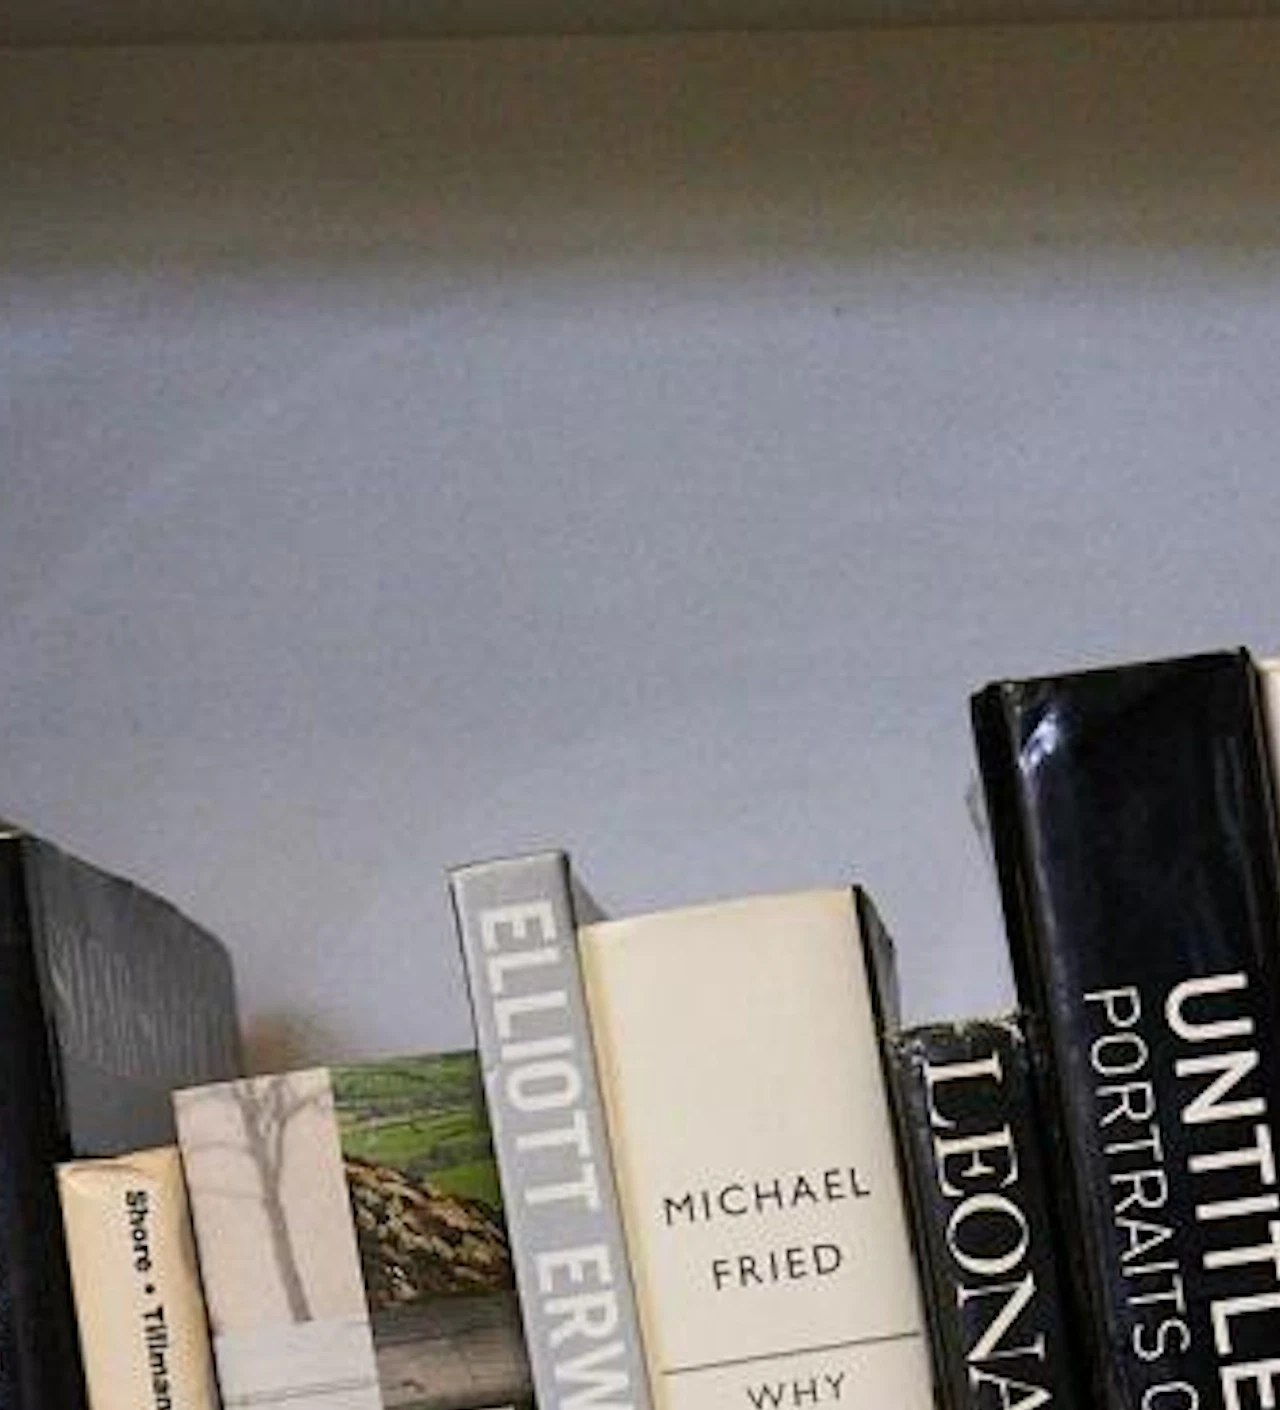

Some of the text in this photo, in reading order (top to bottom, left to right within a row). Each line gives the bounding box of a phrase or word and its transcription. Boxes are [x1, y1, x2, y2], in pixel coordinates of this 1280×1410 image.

[476, 901, 601, 1211] ELLIOTT
[663, 1167, 871, 1226] MICHAEL
[1084, 986, 1191, 1360] PORTRAITS
[125, 1189, 155, 1273] Shore
[712, 1243, 842, 1291] FRIED
[747, 1372, 846, 1410] WHY
